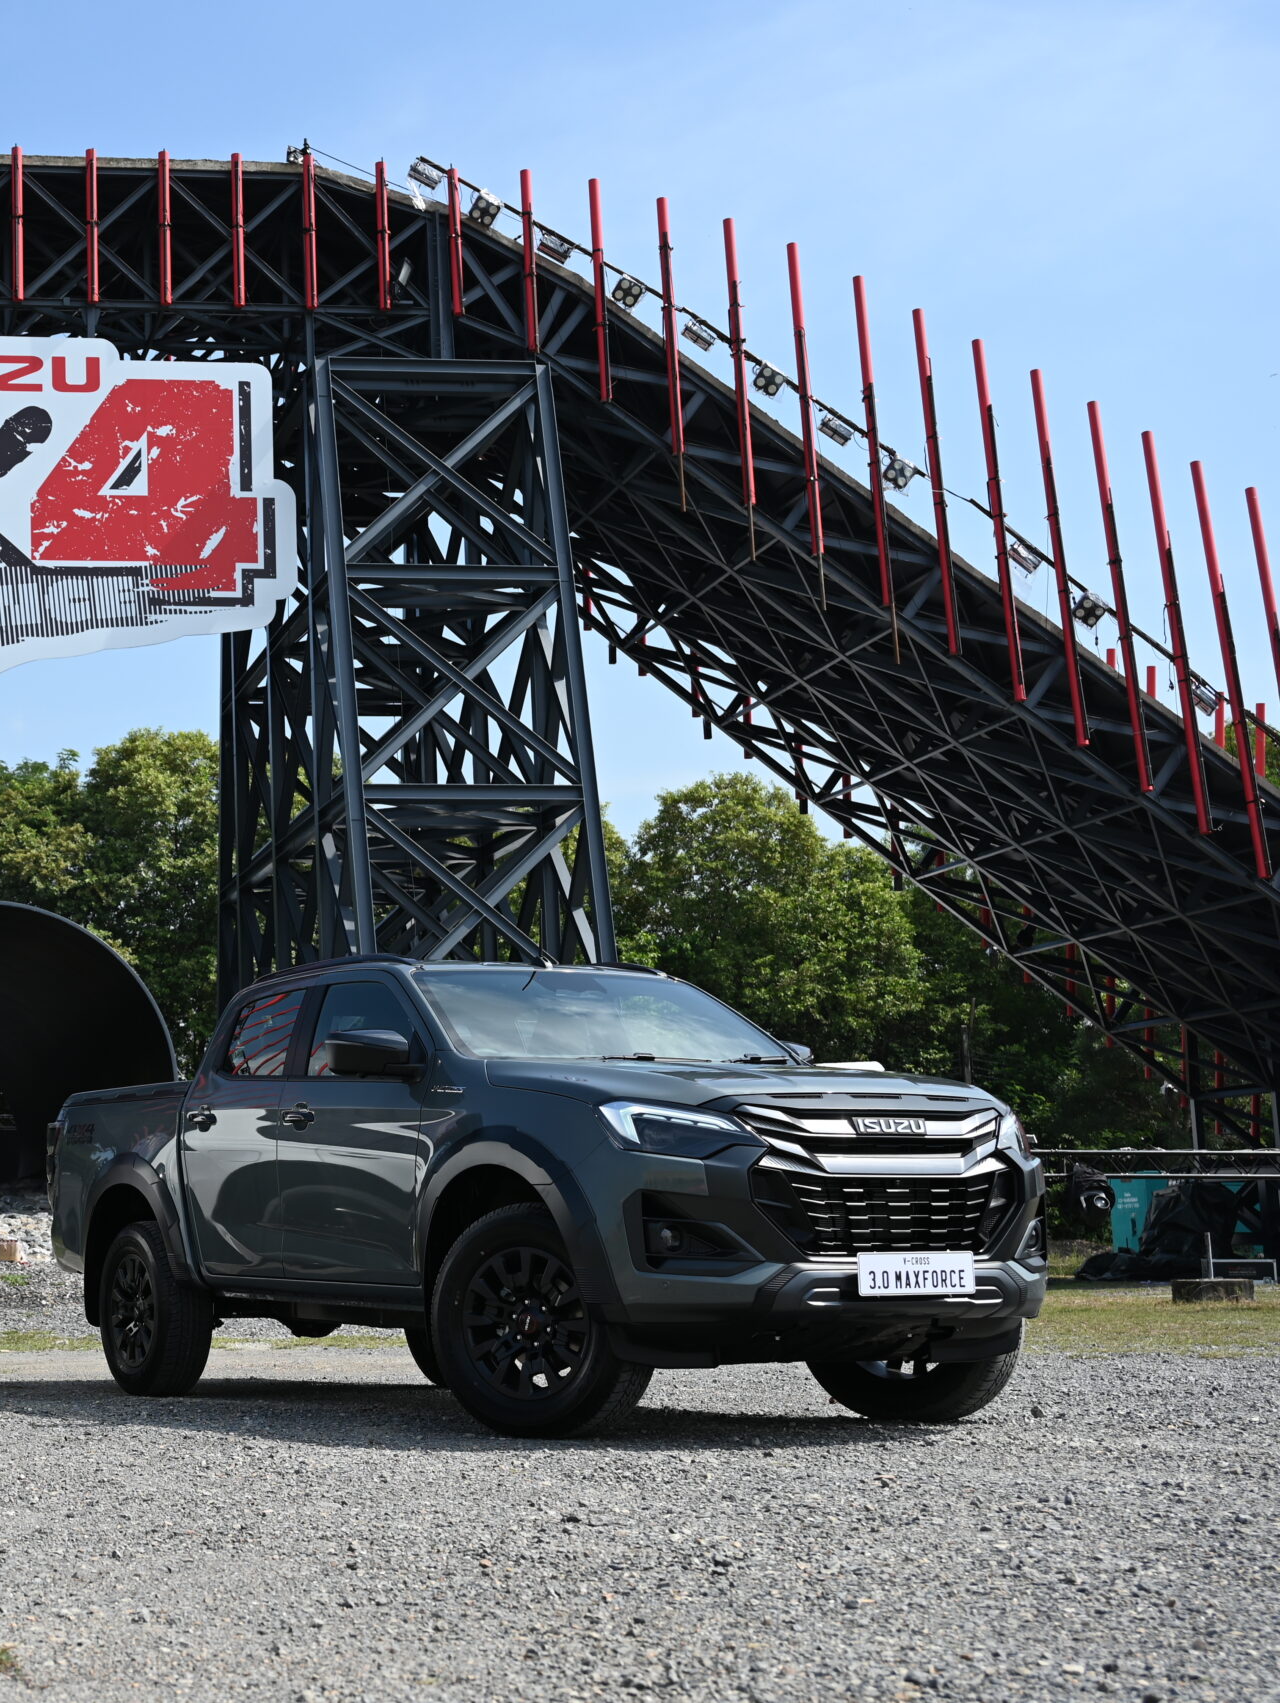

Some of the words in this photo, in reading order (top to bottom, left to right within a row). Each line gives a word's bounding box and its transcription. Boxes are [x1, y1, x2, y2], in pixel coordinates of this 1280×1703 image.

[856, 1118, 926, 1133] ISUZU
[903, 1257, 930, 1265] V-CROSS
[869, 1270, 889, 1289] 3.0
[895, 1269, 966, 1289] MAXFORCE
